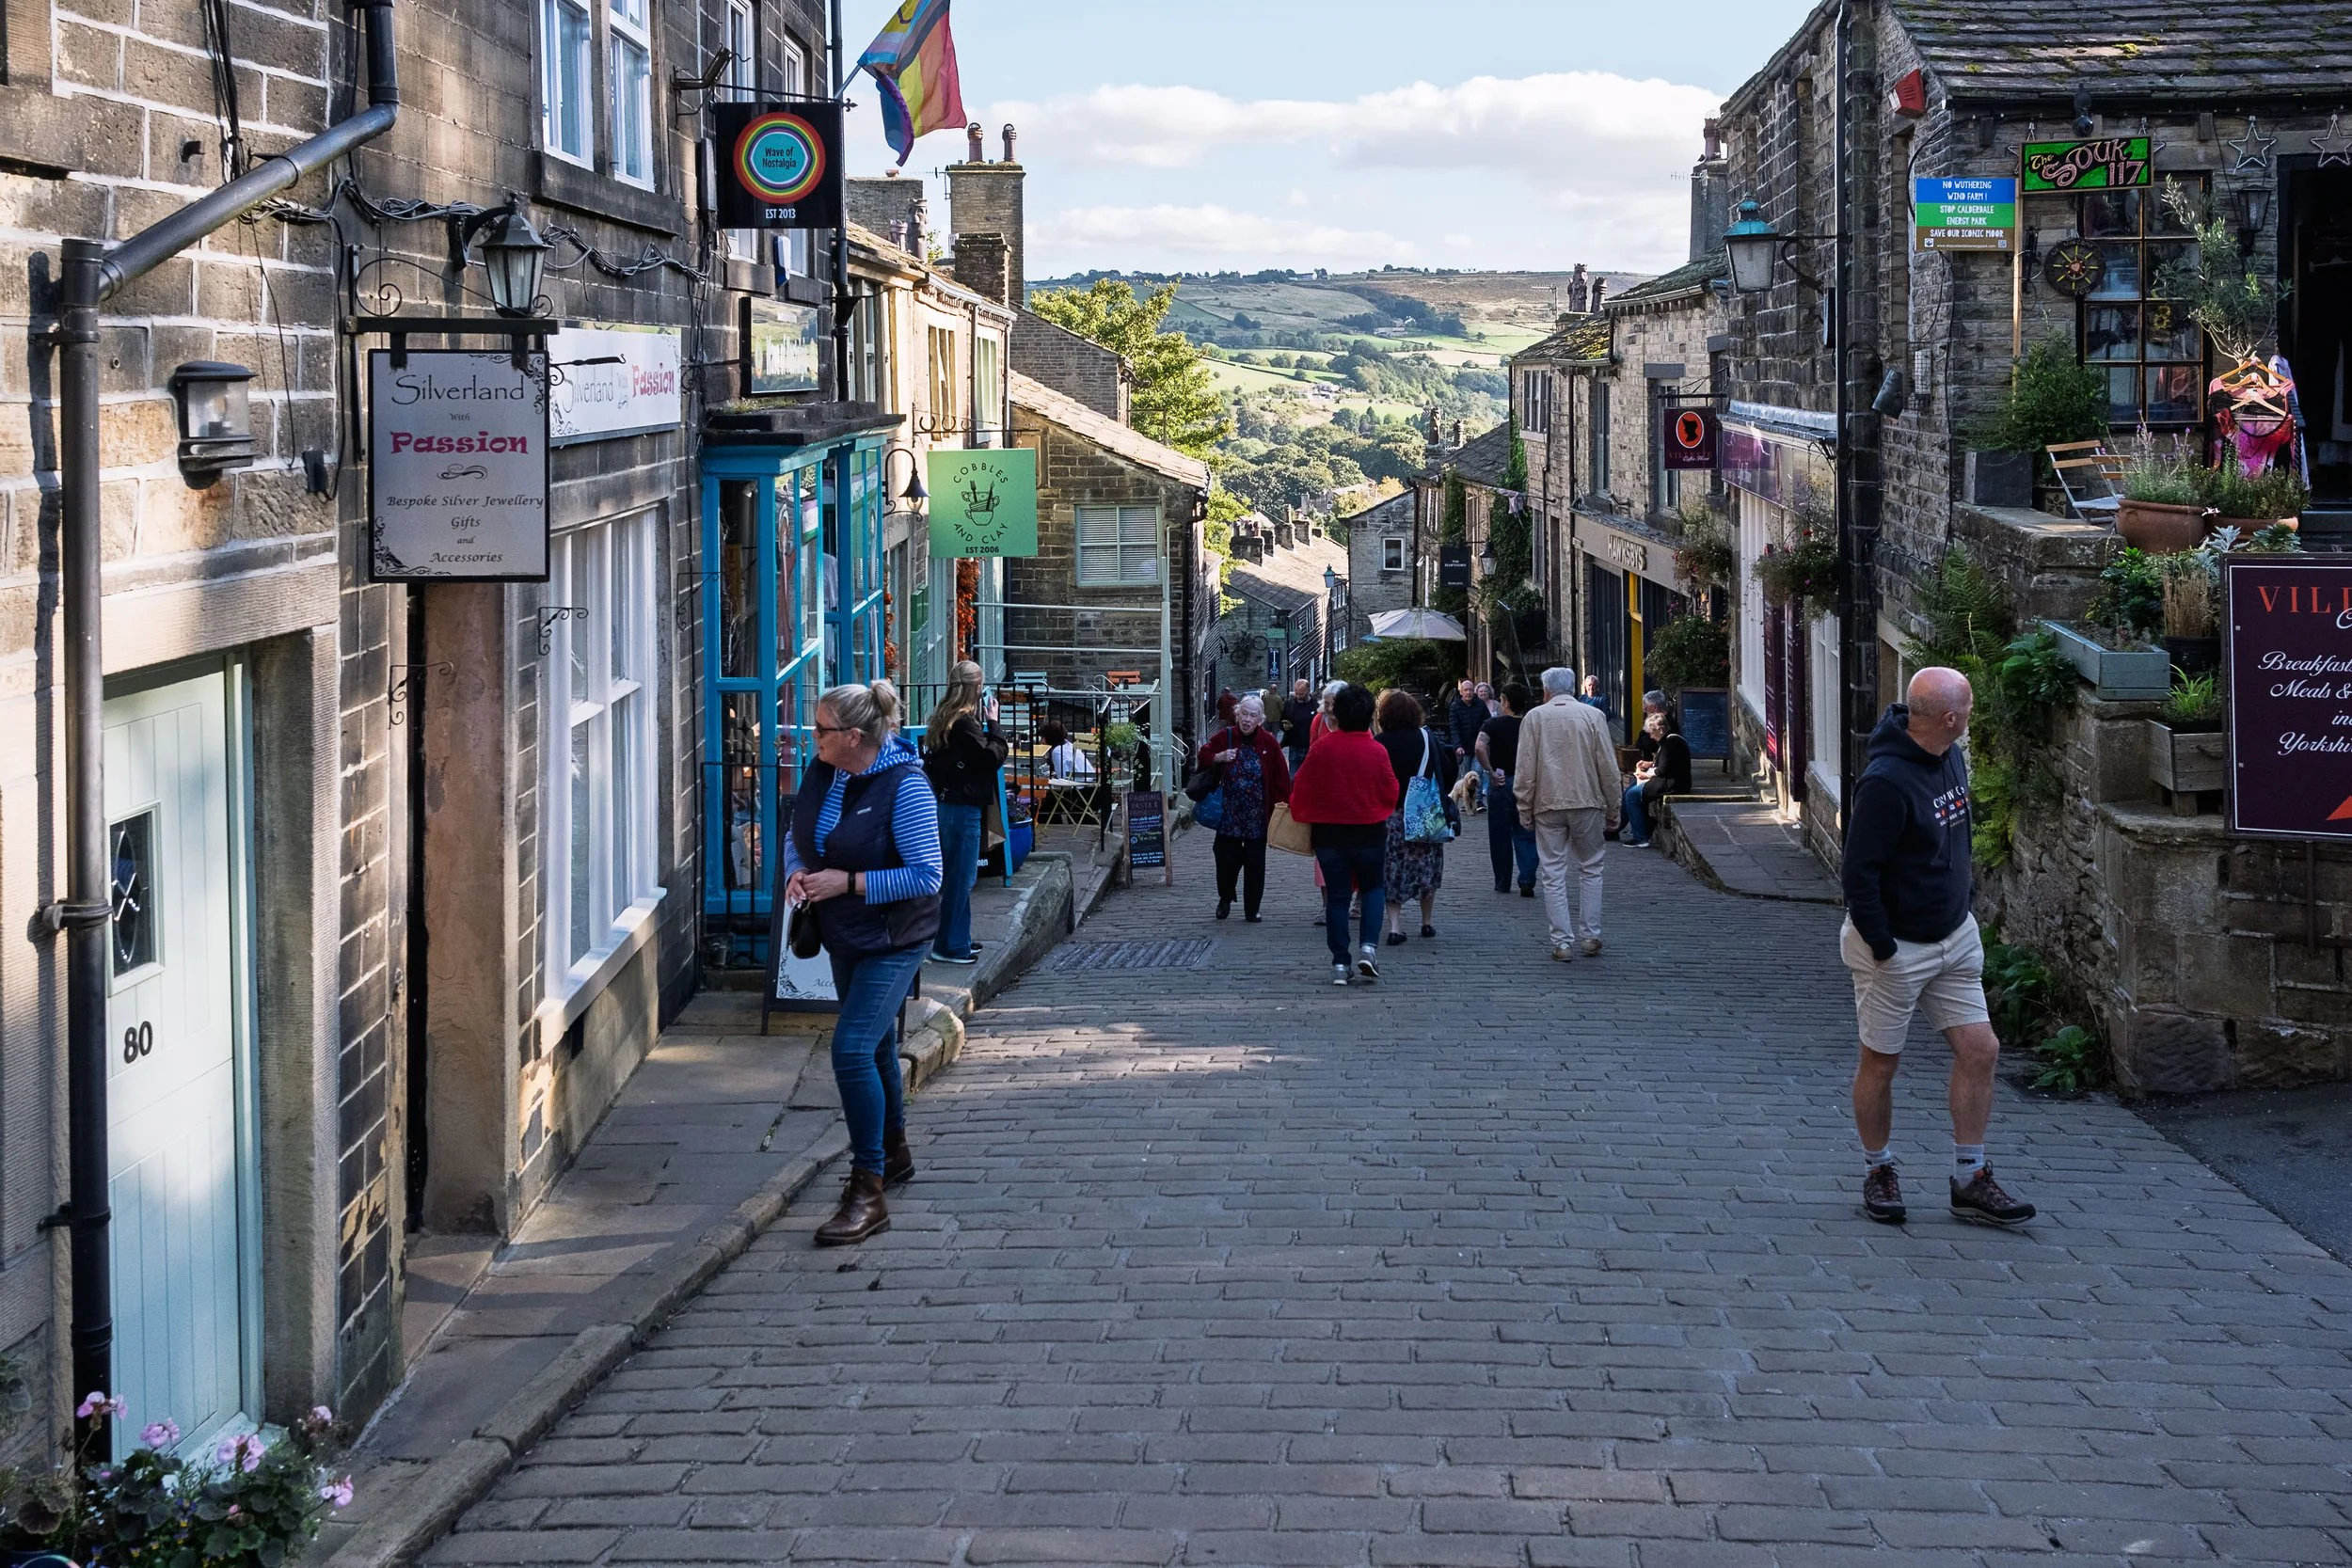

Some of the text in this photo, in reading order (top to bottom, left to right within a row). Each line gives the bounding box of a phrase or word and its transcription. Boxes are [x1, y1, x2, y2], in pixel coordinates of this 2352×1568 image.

[765, 147, 794, 157] Wave of
[762, 158, 797, 169] Nostalgia
[2030, 154, 2054, 170] The
[2108, 161, 2145, 186] 117
[1942, 181, 1992, 189] NO WUTHERING
[1947, 192, 1965, 200] WIND
[1966, 192, 1984, 200] FARM
[765, 209, 796, 218] EST 2013
[1940, 205, 1994, 214] STOP CALDERDALE
[1947, 216, 1987, 226] ENERGY PARK
[1930, 229, 2004, 238] SAVE OUR ICONIC MOOR
[632, 362, 675, 398] Passion
[391, 373, 525, 405] Silverland
[450, 412, 471, 422] With
[389, 430, 529, 454] Passion
[953, 462, 1008, 483] COBBLES
[387, 494, 544, 510] Bespoke Silver Jewellery
[451, 515, 481, 531] Gifts
[456, 535, 476, 545] and
[954, 522, 1009, 544] AND CLAY
[429, 551, 503, 563] Accessories
[979, 546, 1000, 554] 2006
[2258, 651, 2352, 676] Breakfast
[2270, 679, 2331, 699] Meals
[123, 1021, 153, 1064] 80
